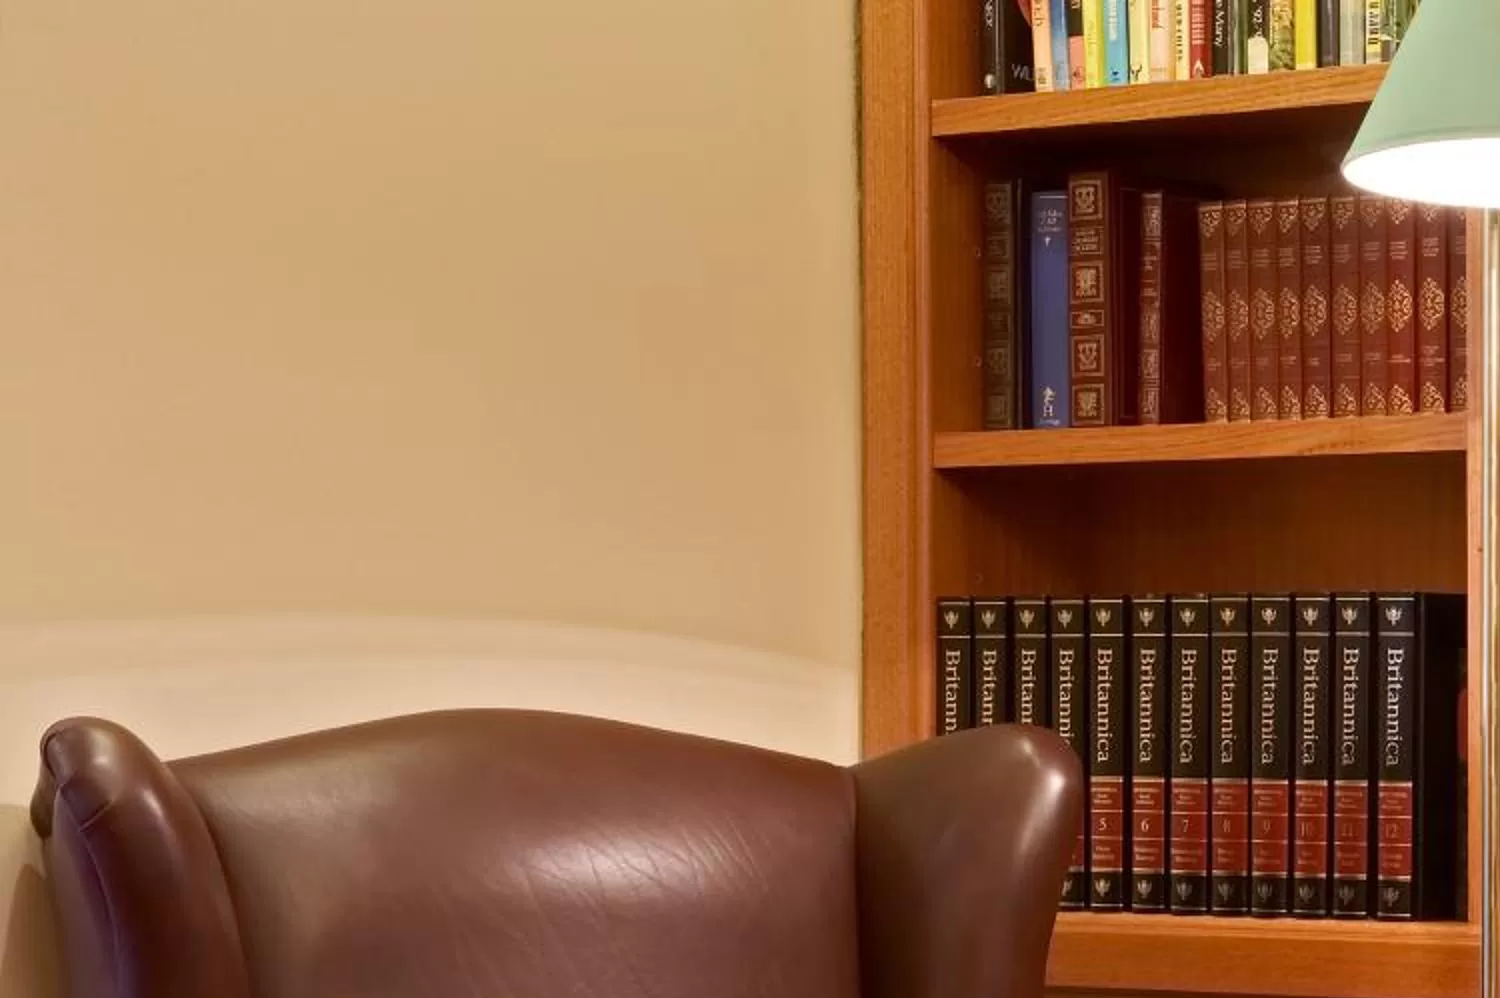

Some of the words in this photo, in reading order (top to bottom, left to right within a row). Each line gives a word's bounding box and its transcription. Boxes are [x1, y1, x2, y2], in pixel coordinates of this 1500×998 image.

[945, 649, 961, 735] Britann
[1021, 649, 1037, 724] Britan
[1059, 649, 1075, 745] Britanni
[1097, 647, 1113, 763] Britannica
[1139, 648, 1156, 762] Britannica
[1179, 648, 1197, 763] Britannica
[1221, 647, 1237, 763] Britannica
[1261, 647, 1279, 764] Britannica
[1303, 646, 1320, 764] Britannica
[1342, 646, 1360, 764] Britannica
[1386, 646, 1404, 765] Britannica
[1099, 817, 1108, 830] 5
[1140, 818, 1149, 832] 6
[1182, 819, 1189, 833] 7
